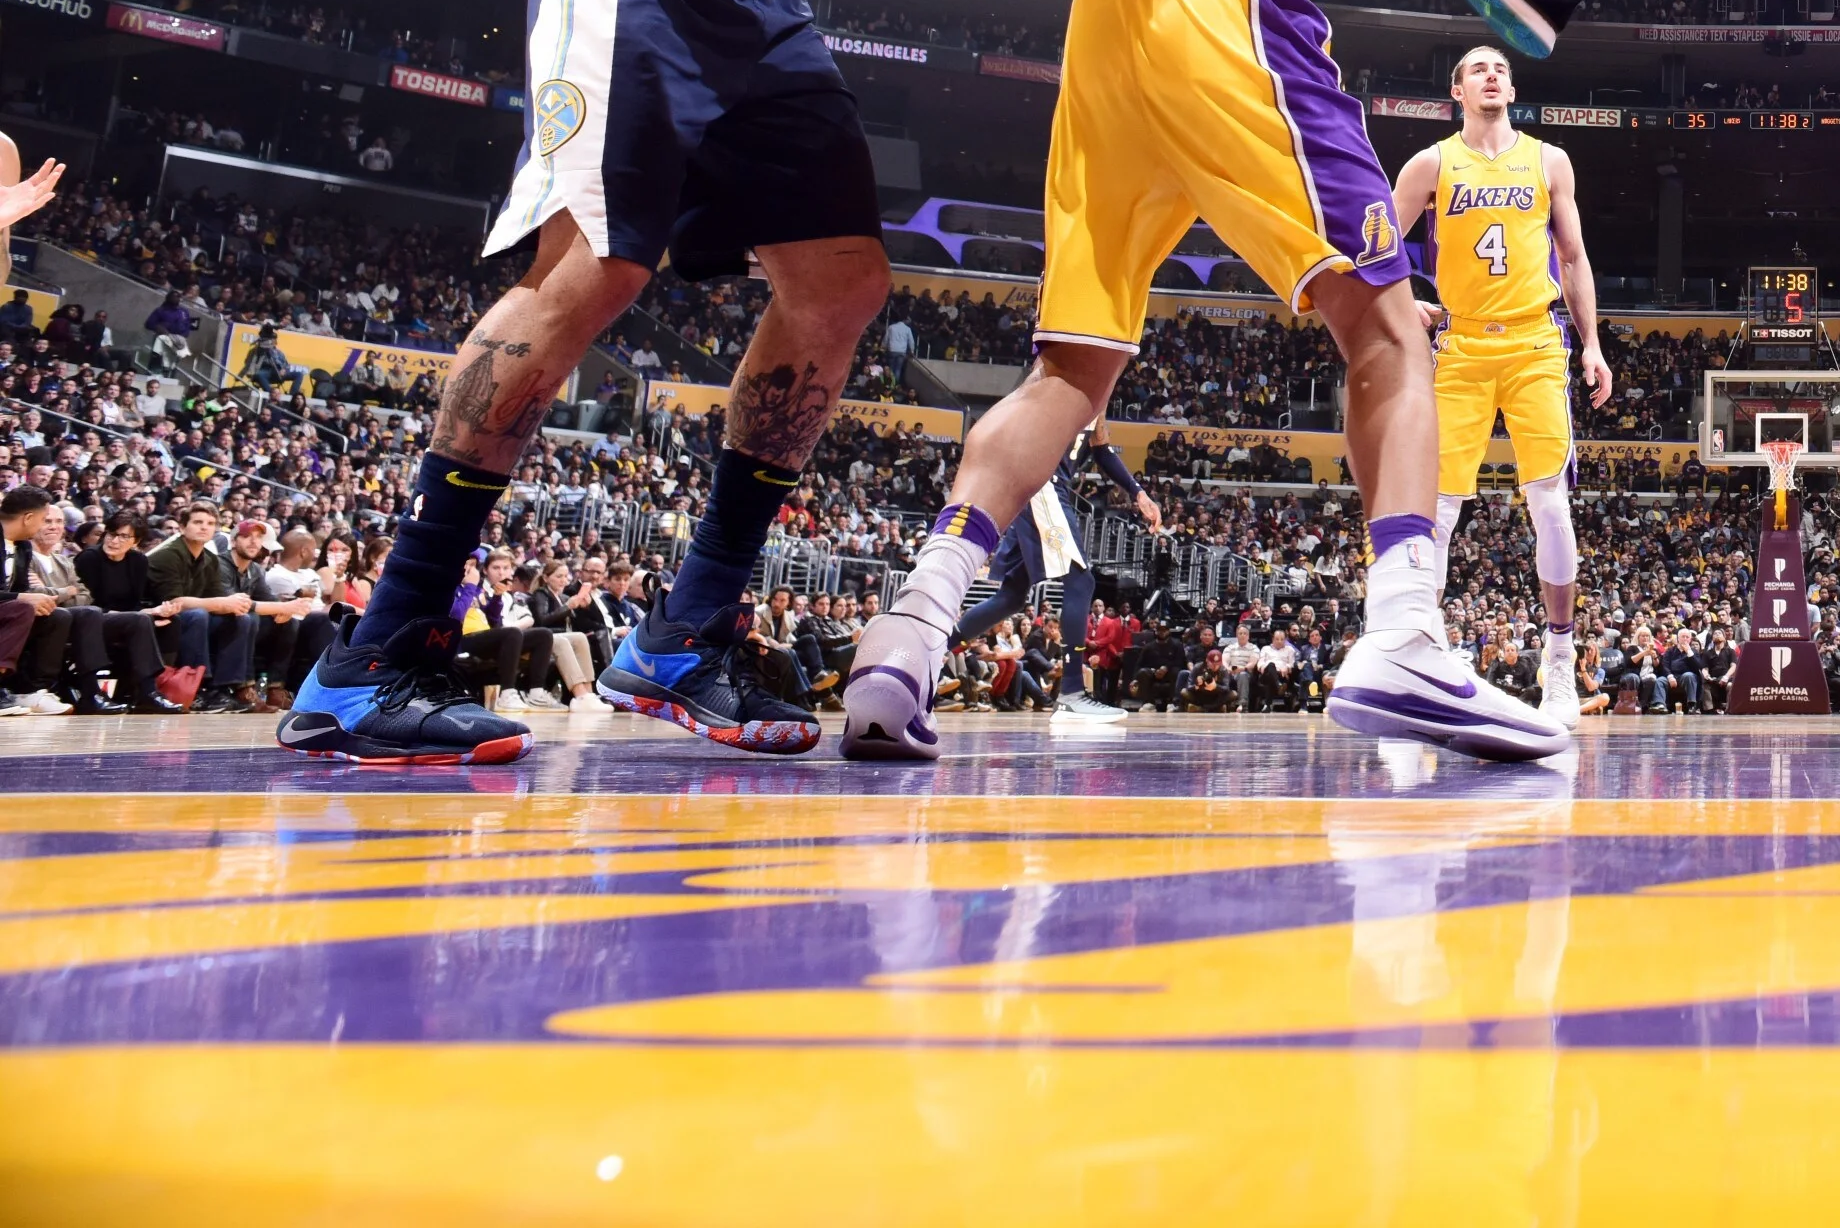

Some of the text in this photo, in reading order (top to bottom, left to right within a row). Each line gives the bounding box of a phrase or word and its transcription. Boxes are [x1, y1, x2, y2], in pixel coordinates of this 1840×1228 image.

[1639, 28, 1658, 40] NEED
[1660, 29, 1708, 42] ASSISTANCE?
[1710, 29, 1728, 42] TEXT
[1812, 33, 1824, 42] AND
[393, 68, 486, 103] TOSHIBA
[1542, 107, 1619, 126] STAPLES
[1631, 117, 1639, 128] 6
[1687, 113, 1706, 128] 35
[1760, 114, 1797, 128] 11:38
[1802, 118, 1809, 128] 2
[1506, 163, 1531, 173] wish
[1446, 183, 1535, 217] LAKERS
[1473, 223, 1508, 277] 4
[1764, 273, 1808, 291] 11:38
[1785, 292, 1803, 323] 5
[1769, 329, 1813, 338] TISSOT
[375, 351, 409, 366] LOS
[1191, 430, 1219, 441] LOS
[1575, 444, 1594, 455] OS
[1750, 686, 1809, 696] PECHANGA
[1750, 694, 1779, 702] RESORT
